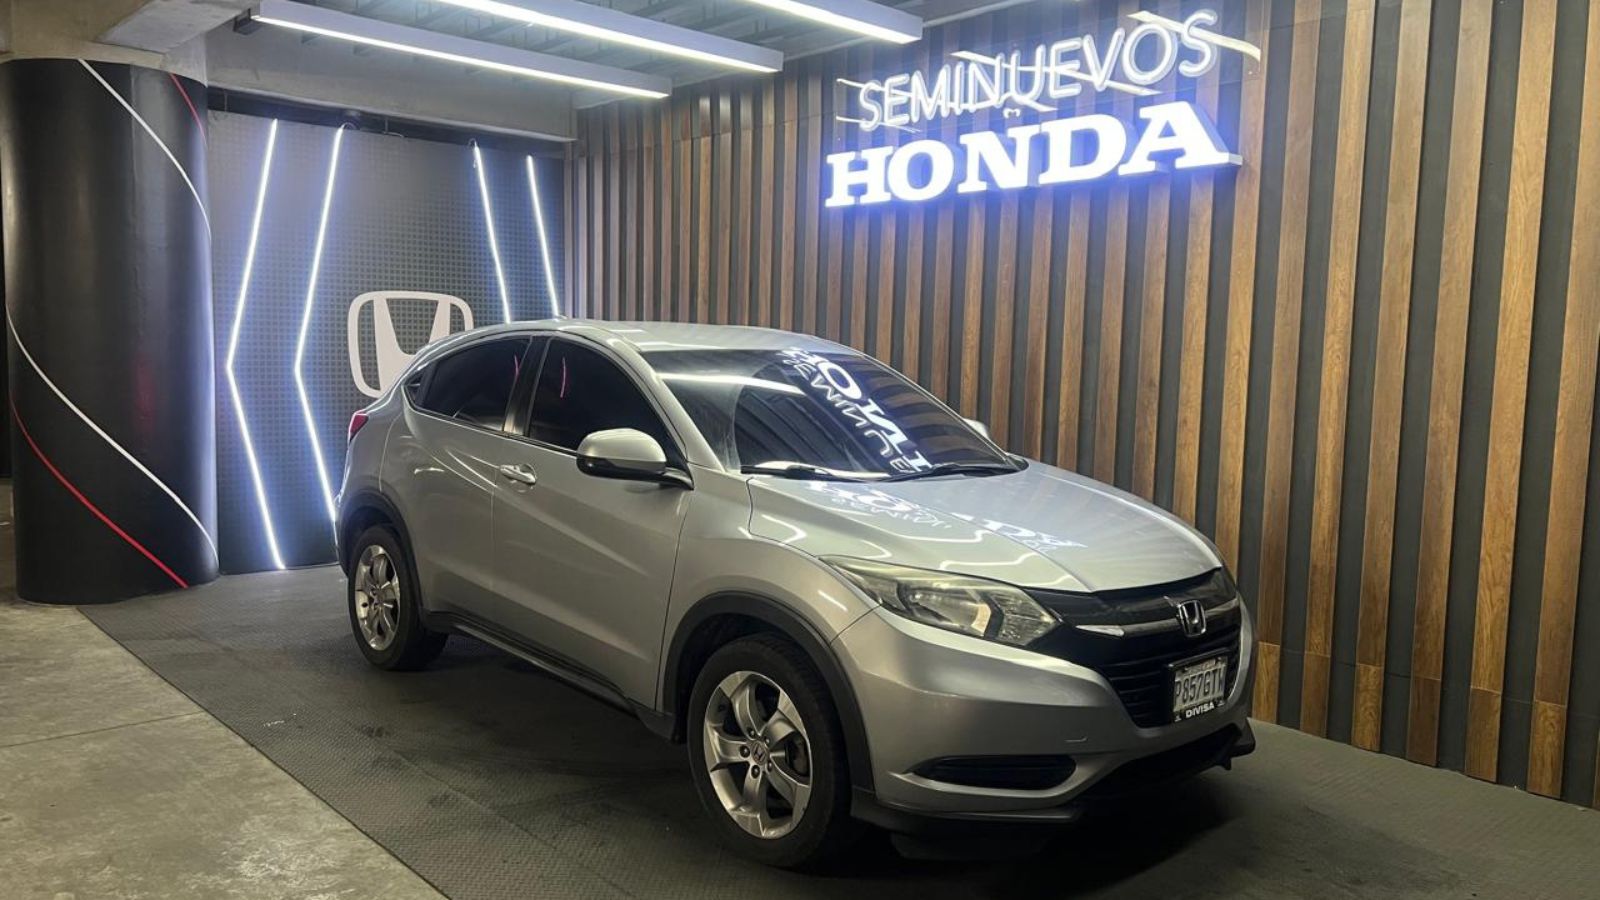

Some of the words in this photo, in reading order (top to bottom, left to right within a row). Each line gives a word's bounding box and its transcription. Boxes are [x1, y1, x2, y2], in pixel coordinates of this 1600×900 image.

[859, 9, 1217, 132] SEMINUEVOS
[825, 101, 1236, 207] HONDA
[1185, 701, 1215, 719] DIVISA
